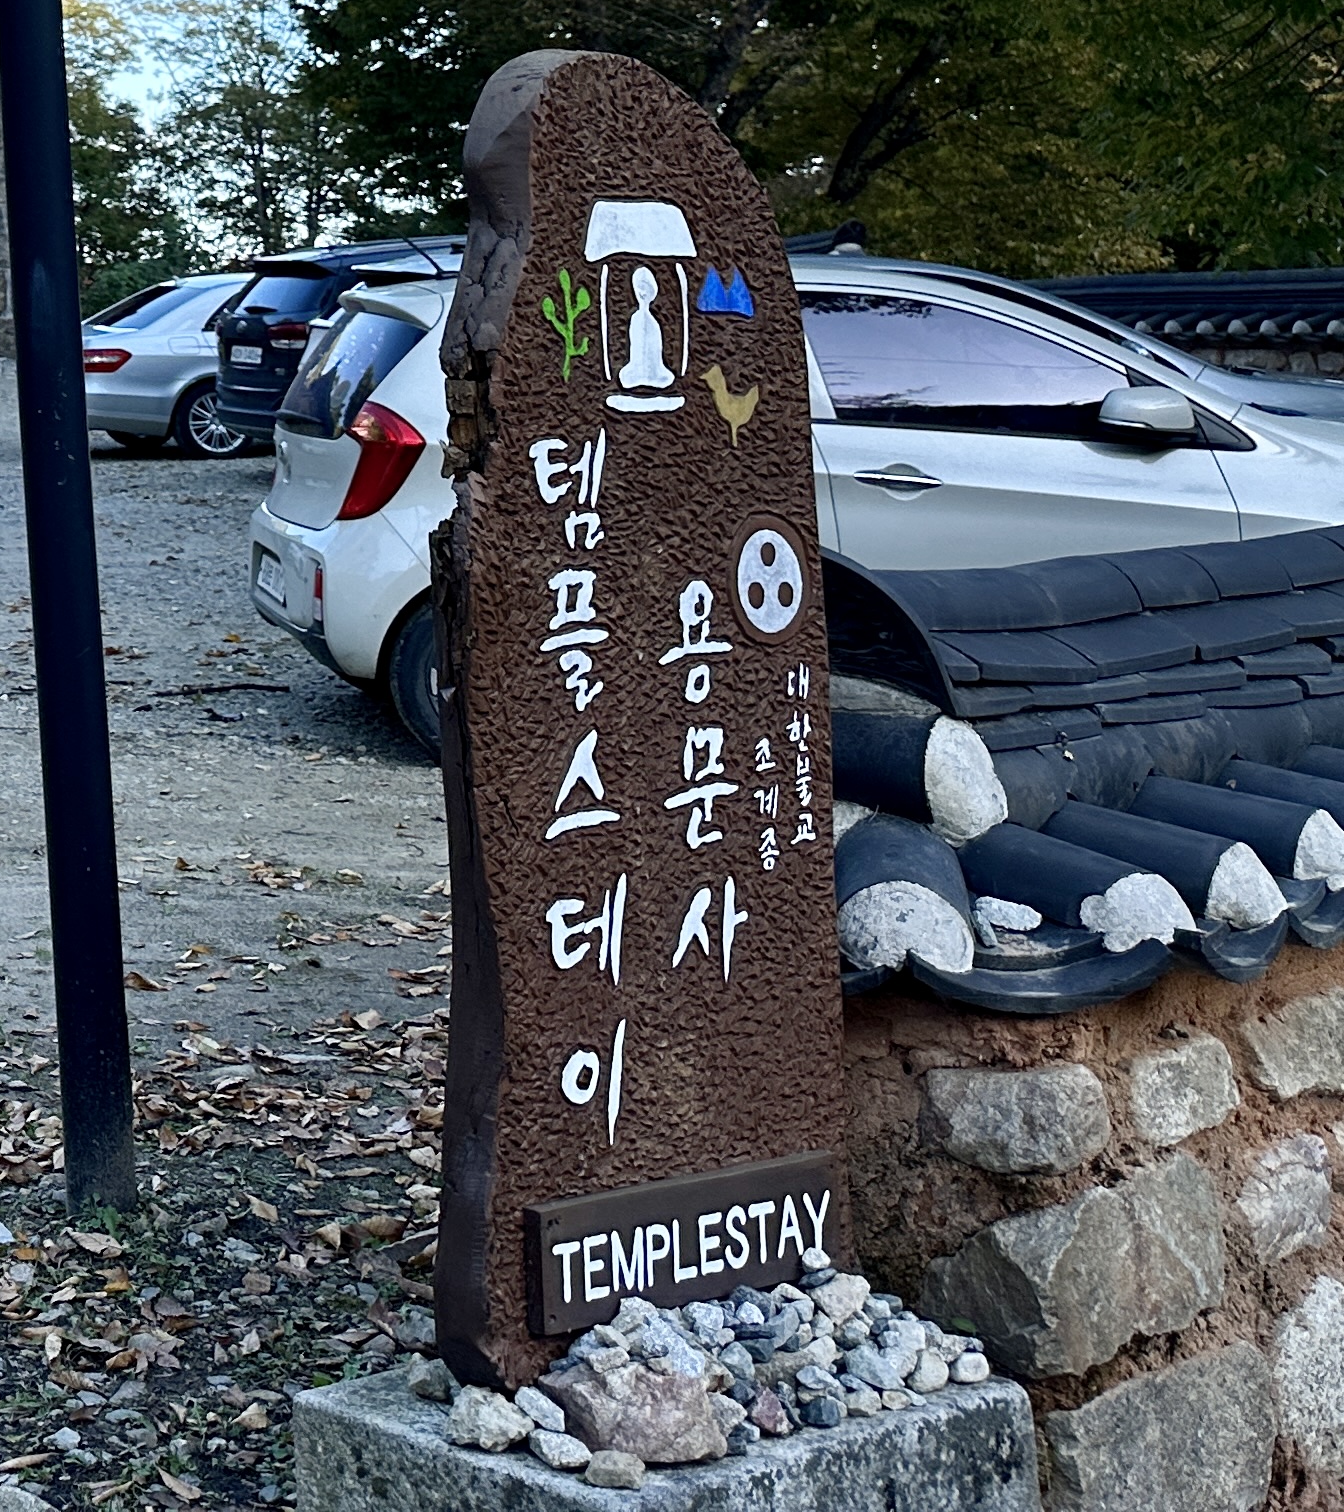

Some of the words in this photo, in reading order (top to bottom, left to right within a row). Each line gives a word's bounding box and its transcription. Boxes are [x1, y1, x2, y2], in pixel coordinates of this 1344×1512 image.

[529, 427, 627, 1146] 템플스테이
[658, 579, 749, 982] 용문사
[754, 737, 780, 871] 조계종
[786, 662, 816, 845] 대한불교
[552, 1190, 831, 1304] TEMPLESTAY
